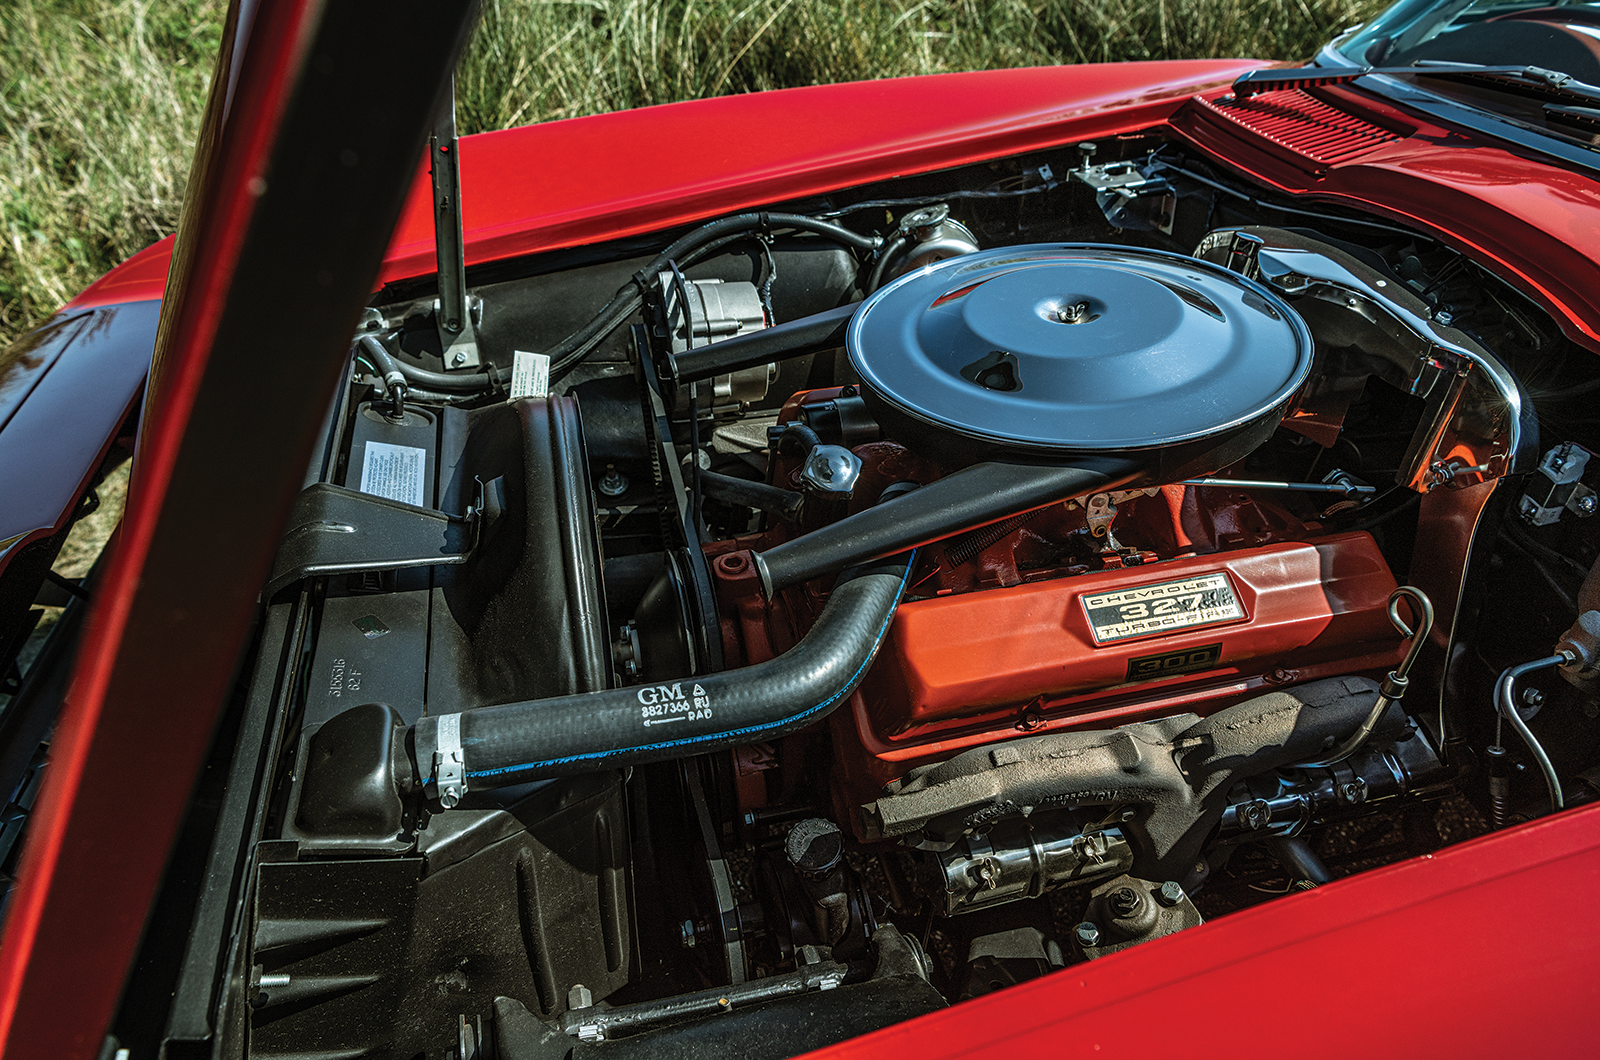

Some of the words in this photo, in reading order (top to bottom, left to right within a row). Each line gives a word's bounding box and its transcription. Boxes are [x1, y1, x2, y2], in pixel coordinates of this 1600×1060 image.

[1090, 579, 1220, 606] CHEVROLET
[1119, 593, 1203, 620] 327
[1138, 651, 1211, 673] 300
[637, 682, 686, 705] GM
[693, 695, 710, 709] RU
[688, 708, 712, 721] RAD
